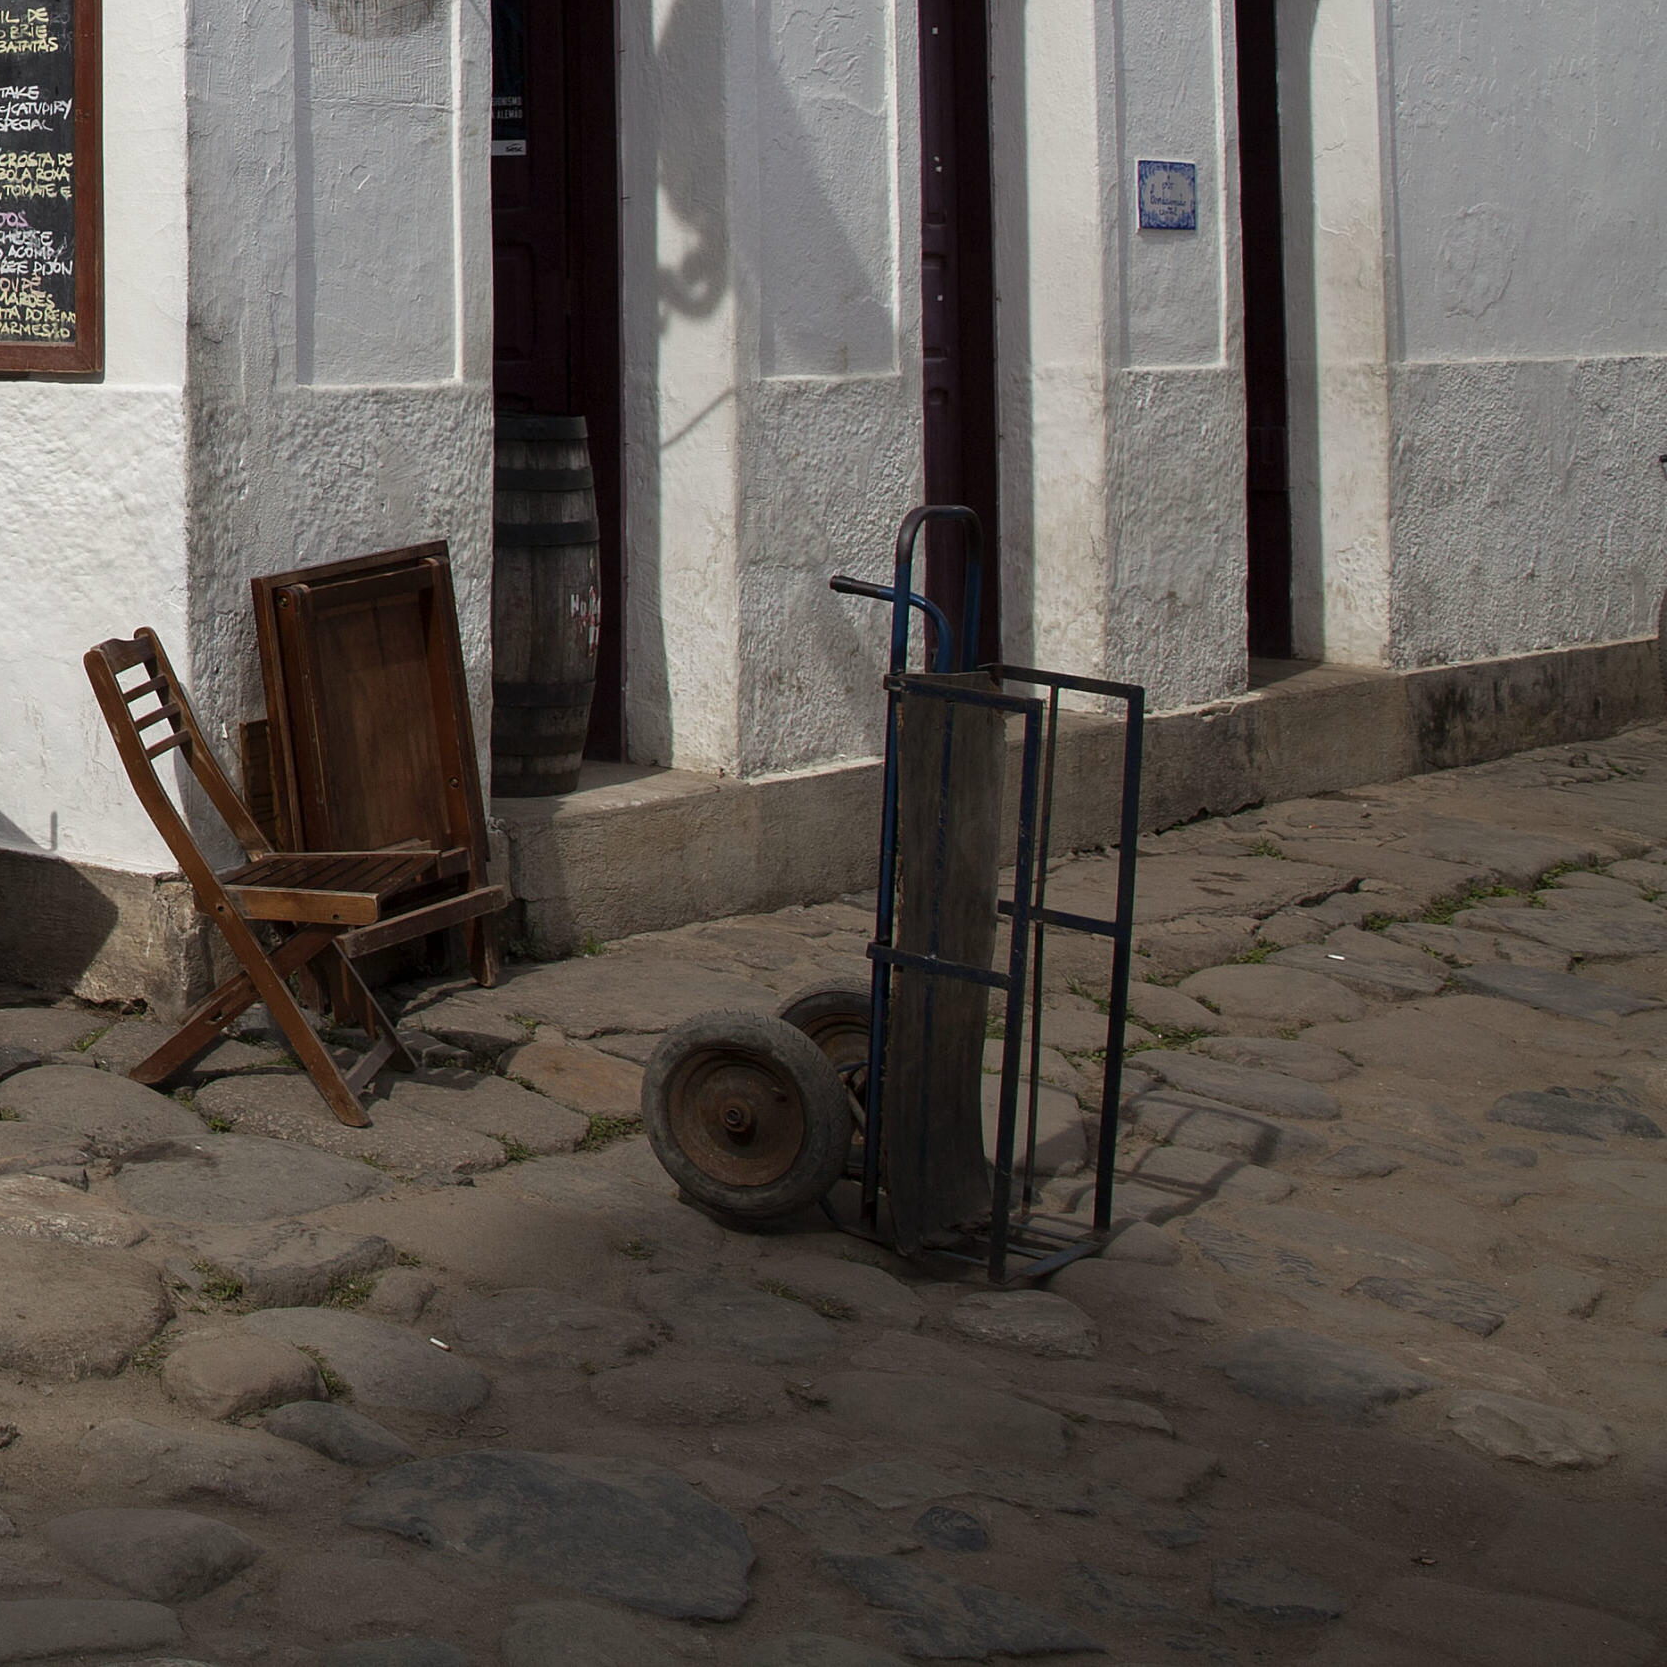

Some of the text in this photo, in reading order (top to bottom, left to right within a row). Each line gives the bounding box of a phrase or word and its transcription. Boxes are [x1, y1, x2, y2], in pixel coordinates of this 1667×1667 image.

[27, 7, 49, 23] DE
[10, 24, 48, 38] BRIE
[58, 152, 74, 166] DE
[36, 167, 70, 181] ROXA
[4, 183, 58, 199] TOMATE
[61, 185, 73, 199] E
[33, 260, 73, 275] DIJON
[25, 308, 43, 321] DO
